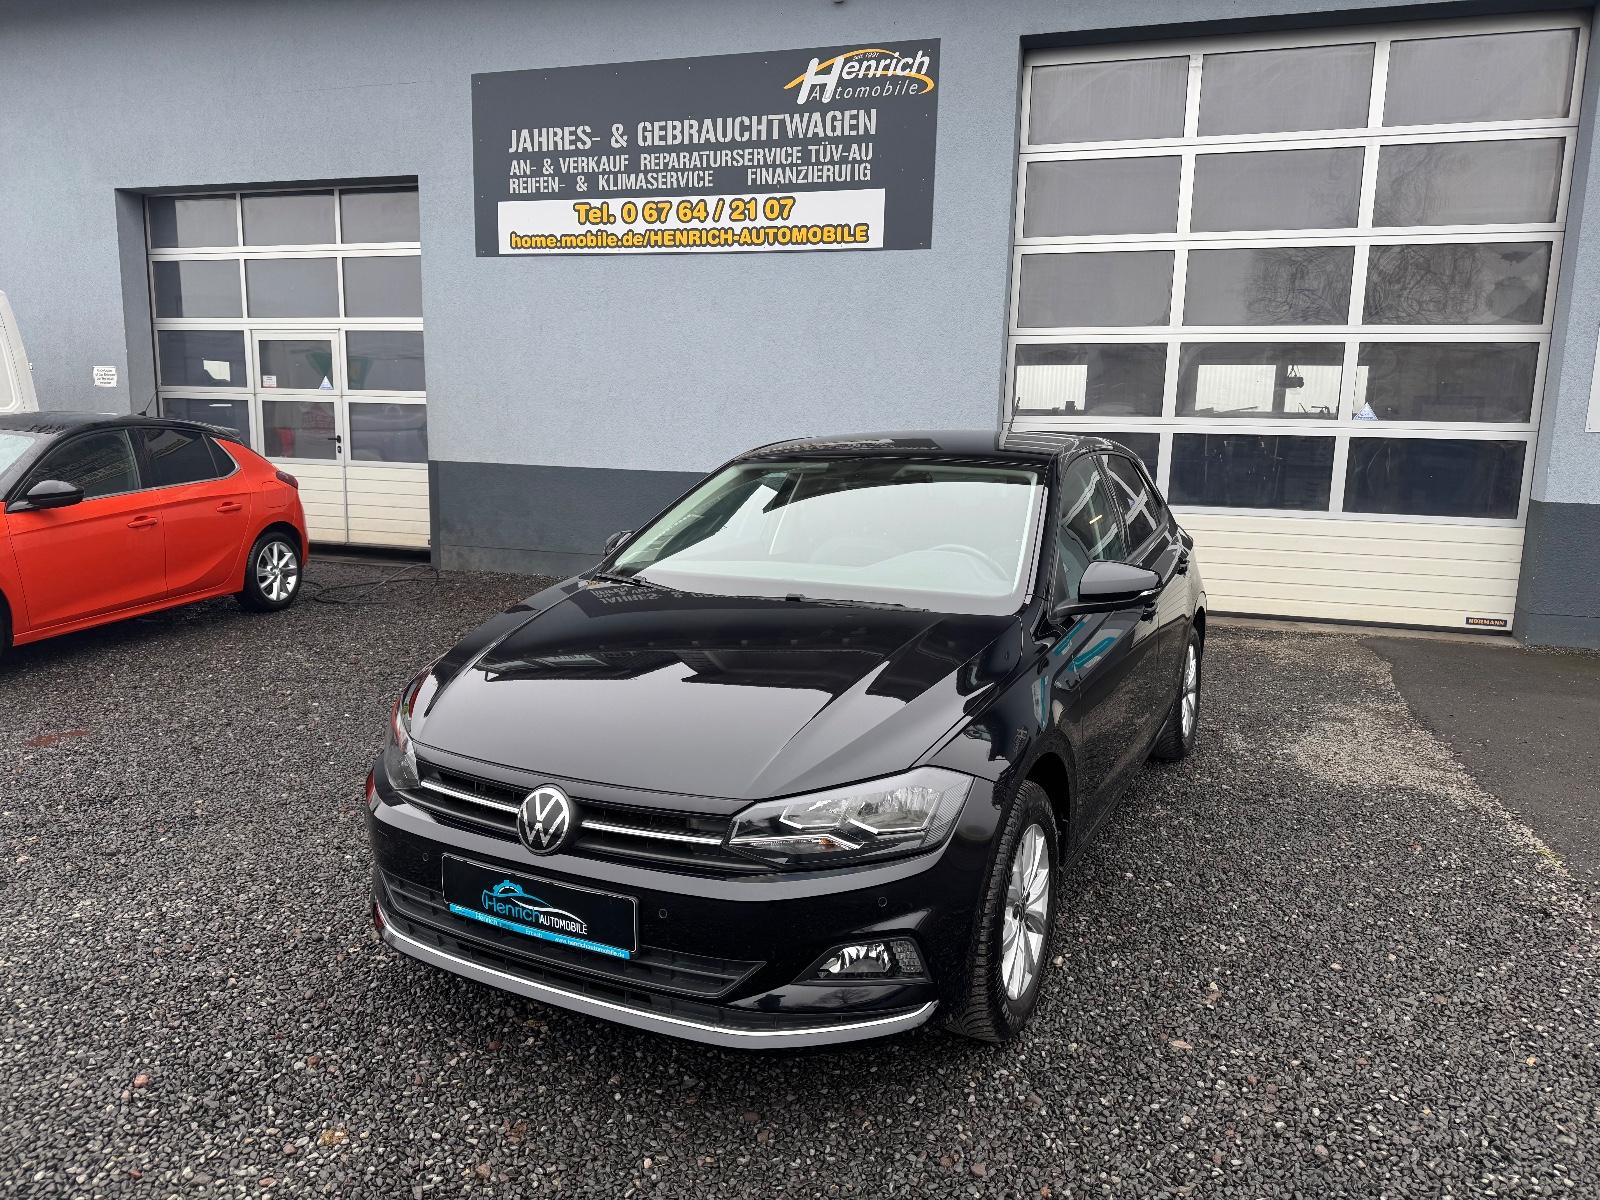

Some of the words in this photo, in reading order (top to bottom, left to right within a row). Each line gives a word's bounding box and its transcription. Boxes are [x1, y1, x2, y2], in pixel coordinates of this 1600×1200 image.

[796, 50, 930, 104] Henrich
[508, 125, 601, 153] JAHRES-
[610, 123, 628, 148] &
[637, 108, 877, 147] GEBRAUCHTWAGEN
[509, 159, 537, 176] AN-
[542, 158, 554, 175] &
[559, 154, 629, 174] VERKAUF
[640, 146, 802, 171] REPARATURSERVICE
[808, 141, 873, 163] TÜV-AU
[509, 176, 566, 194] REIFEN-
[576, 175, 588, 192] &
[598, 170, 714, 192] KLIMASERVICE
[573, 201, 617, 225] Tel.
[621, 201, 638, 225] 0
[642, 200, 673, 224] 67
[676, 199, 709, 224] 64
[712, 197, 726, 223] /
[729, 197, 758, 222] 21
[763, 196, 796, 221] 07
[510, 223, 870, 249] home.mobile.de/HENRICH-AUTOMOBILE
[486, 895, 541, 923] Henrich
[540, 914, 588, 936] AUTOMOBILE
